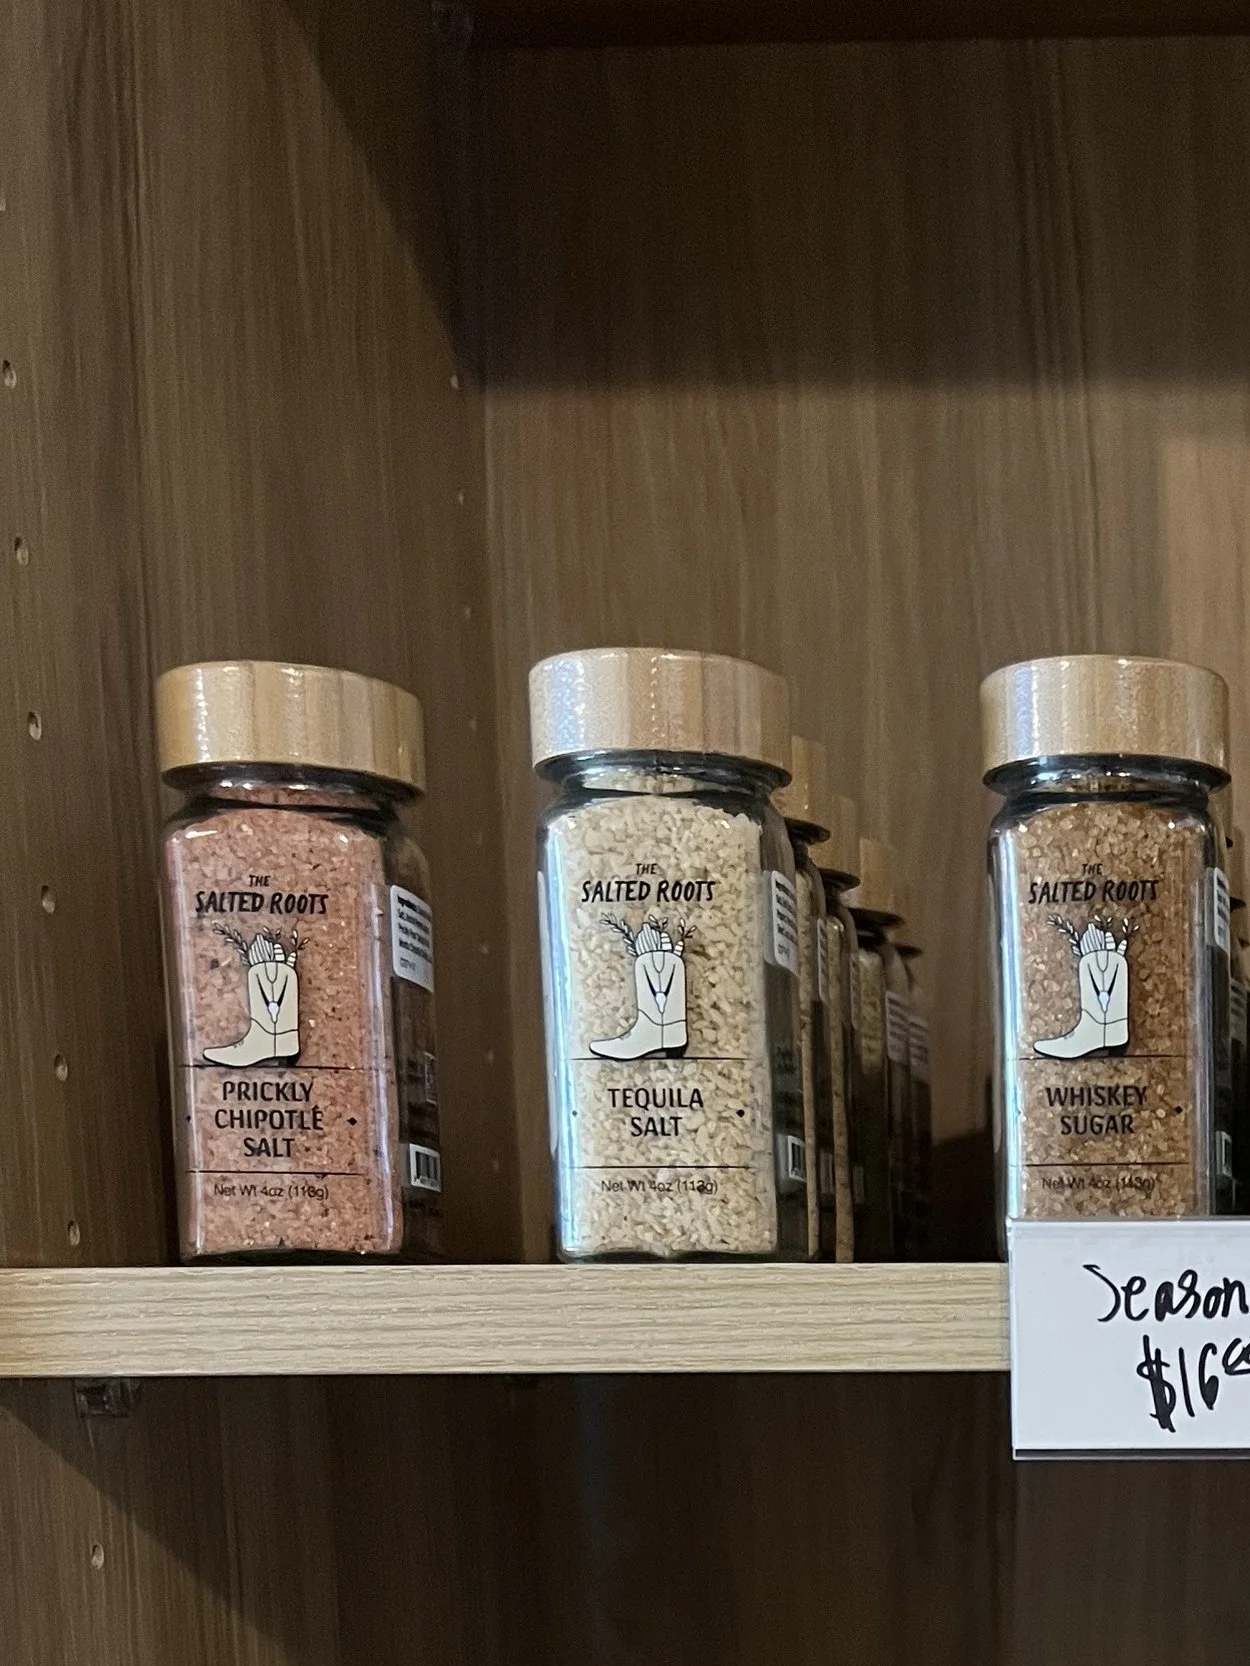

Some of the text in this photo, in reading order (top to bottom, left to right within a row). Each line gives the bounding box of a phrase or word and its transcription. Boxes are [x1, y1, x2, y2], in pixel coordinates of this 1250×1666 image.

[635, 862, 658, 876] THE
[1081, 863, 1103, 876] THE
[248, 874, 271, 887] THE
[1028, 878, 1160, 905] SALTED ROOTS
[194, 891, 330, 915] SALTED ROOTS
[580, 880, 717, 904] SALTED ROOTS
[222, 1080, 314, 1102] PRICKLY
[607, 1087, 704, 1109] TEQUILA
[1044, 1086, 1149, 1108] WHISKEY
[214, 1108, 324, 1131] CHIPOTLE
[630, 1116, 683, 1137] SALT
[1060, 1114, 1135, 1136] SUGAR
[243, 1137, 295, 1158] SALT
[213, 1183, 237, 1197] Net
[260, 1183, 284, 1198] 4oz
[600, 1179, 624, 1193] Net
[648, 1179, 673, 1193] 4oz
